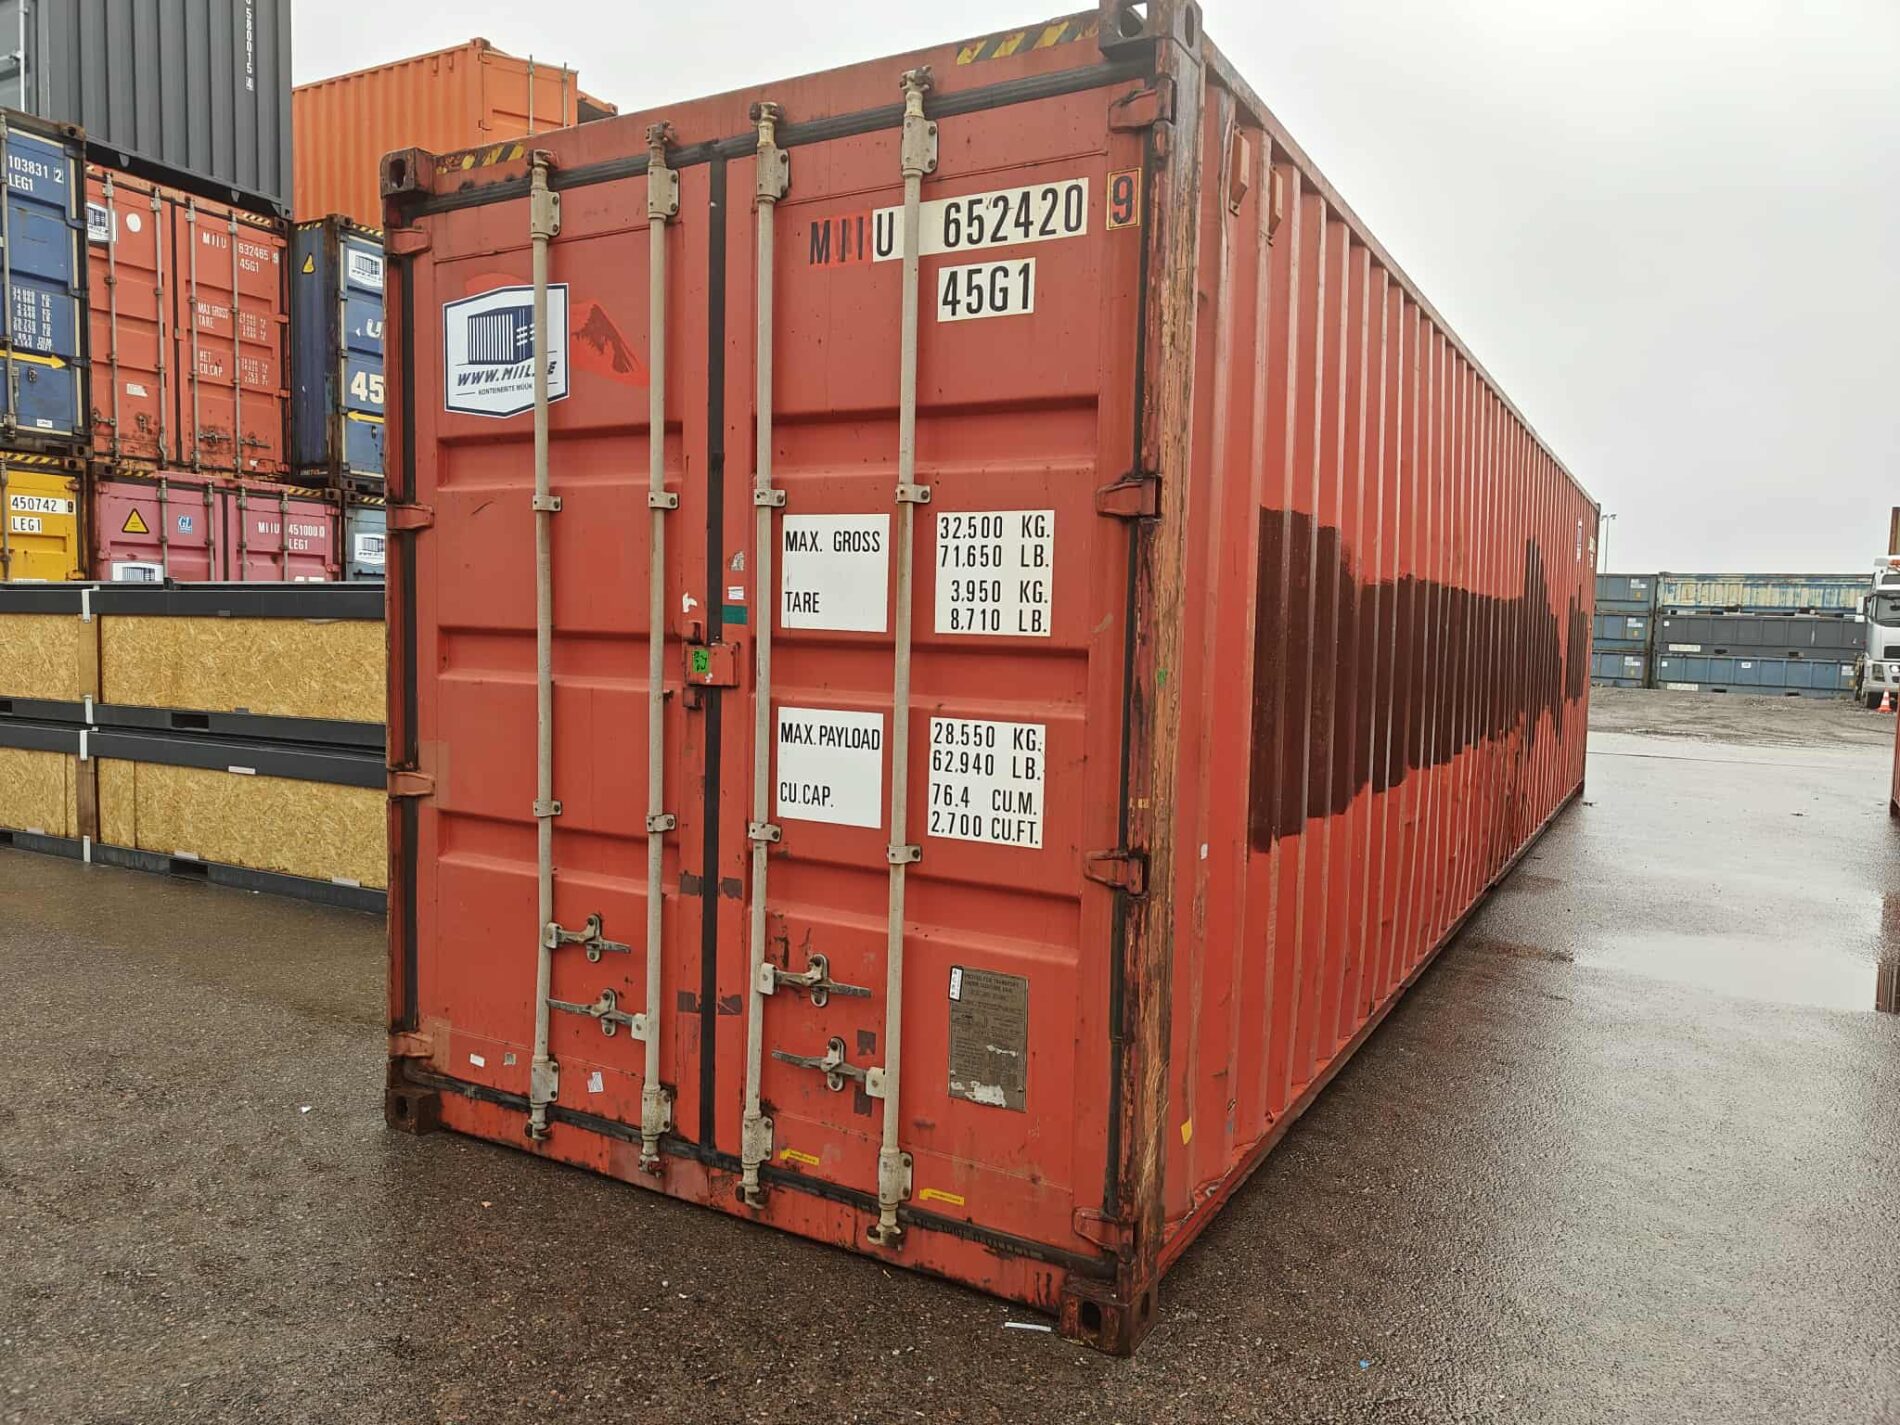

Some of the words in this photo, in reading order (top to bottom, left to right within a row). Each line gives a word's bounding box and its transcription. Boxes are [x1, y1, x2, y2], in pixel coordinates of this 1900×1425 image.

[8, 155, 48, 179] 103831
[54, 168, 64, 184] 2
[8, 172, 33, 192] LEG1
[810, 211, 894, 265] MIIU
[943, 184, 1083, 248] 652420
[1112, 175, 1134, 224] 9
[202, 231, 227, 249] MIIU
[942, 262, 1031, 317] 45G1
[457, 361, 557, 387] WWW.MIIL.E
[351, 371, 384, 403] 45
[12, 496, 57, 512] 450742
[12, 517, 41, 532] LEG1
[258, 521, 280, 534] MIIU
[288, 523, 318, 537] 451000
[1021, 515, 1050, 539] KG.
[288, 538, 308, 550] LEG1
[785, 530, 823, 552] MAX.
[833, 530, 880, 552] GROSS
[1020, 544, 1049, 567] LB.
[784, 591, 820, 613] TARE
[1019, 580, 1048, 604] KG.
[1018, 609, 1047, 633] LB.
[780, 722, 817, 746] MAX.
[819, 725, 880, 750] PAYLOAD
[1013, 727, 1042, 752] KG.
[1012, 755, 1041, 781] LB.
[780, 781, 834, 808] CU.CAP.
[932, 782, 970, 809] 76.4
[992, 789, 1037, 815] CU.M.
[991, 817, 1039, 845] CU.FT.
